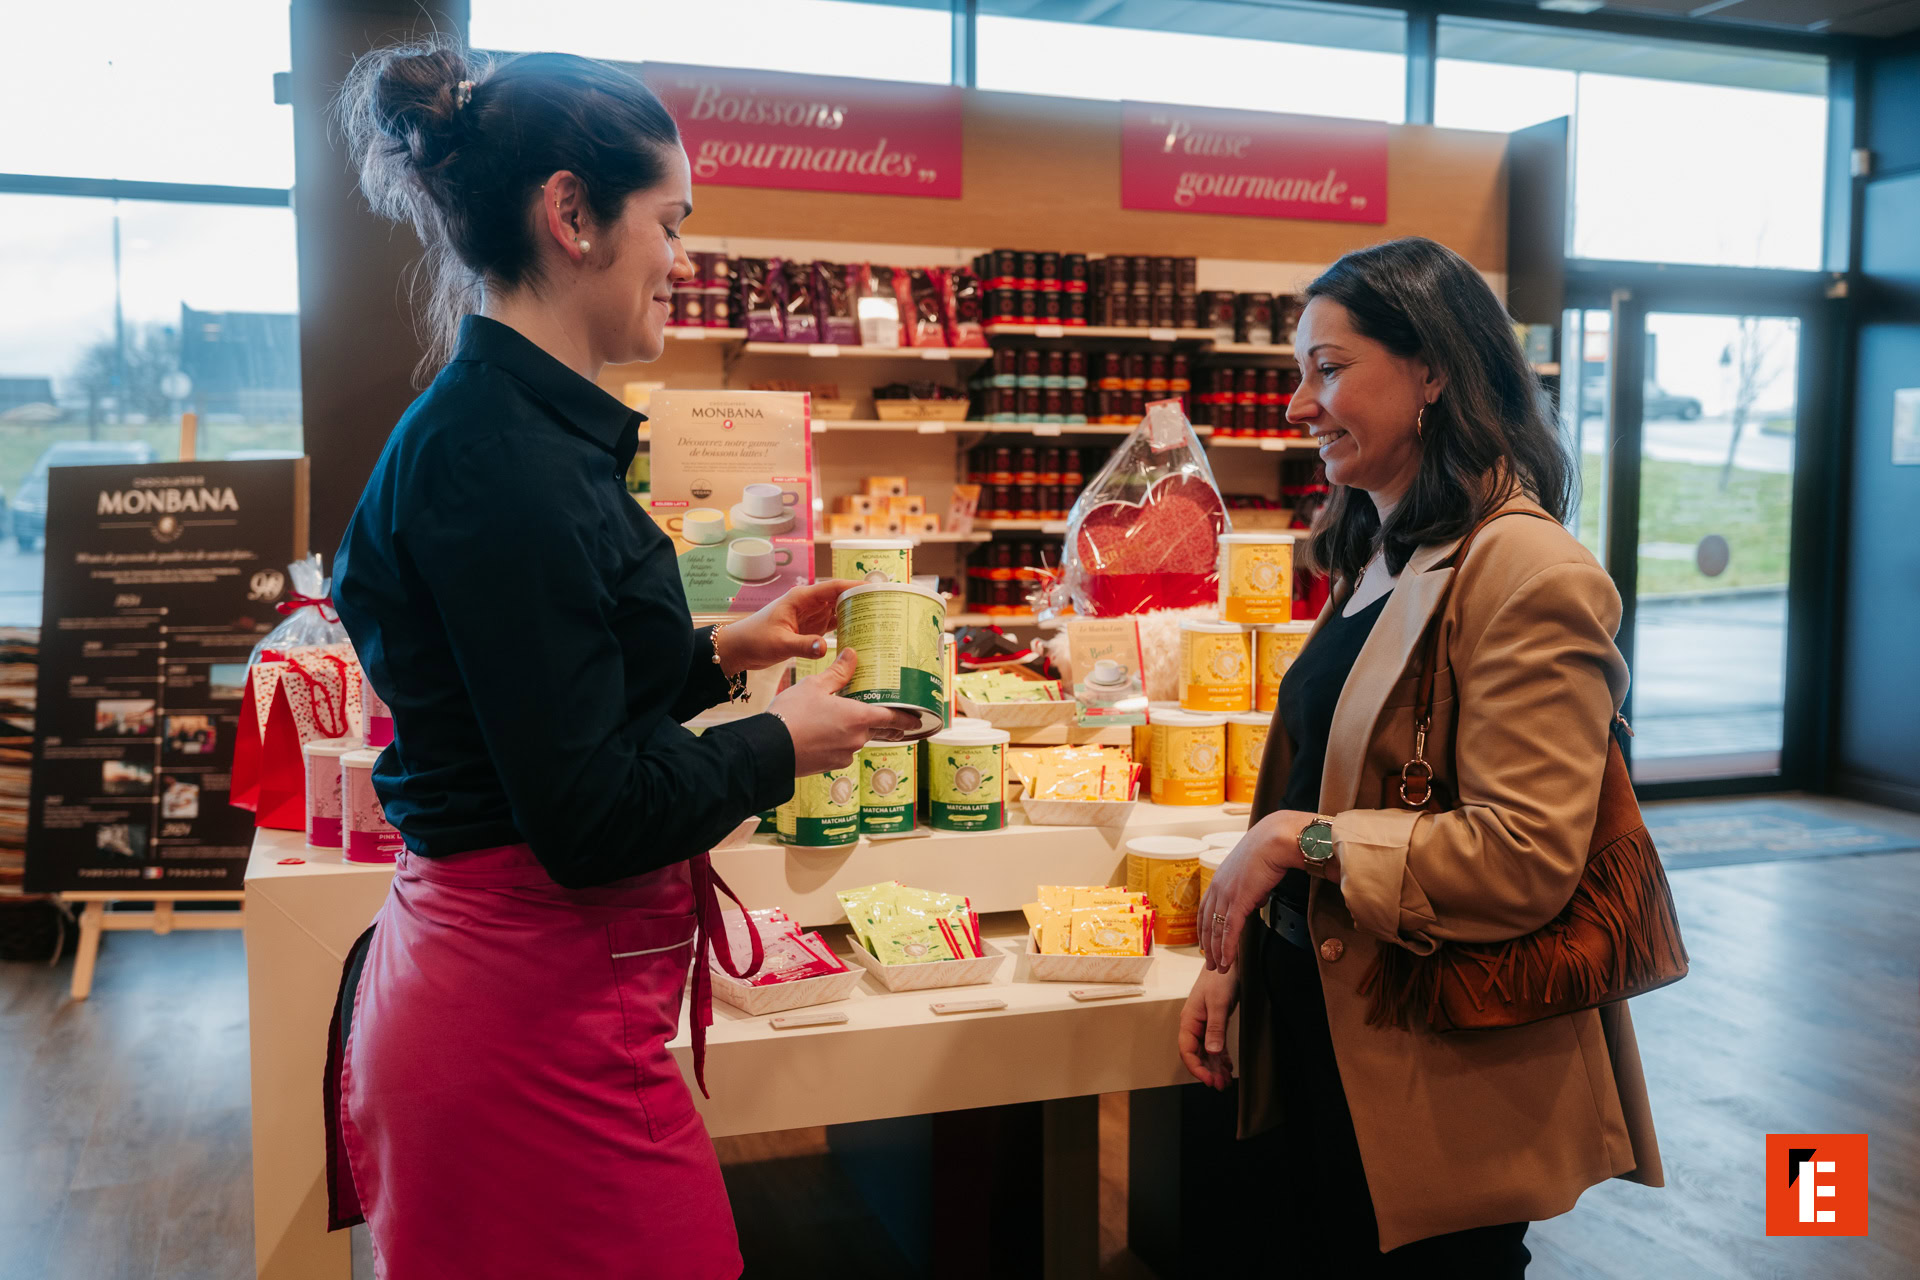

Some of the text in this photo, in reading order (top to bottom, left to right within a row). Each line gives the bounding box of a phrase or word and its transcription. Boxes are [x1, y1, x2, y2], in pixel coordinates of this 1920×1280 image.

[692, 407, 764, 419] MONBANA
[677, 436, 780, 449] Découvrez notre gamme
[689, 447, 701, 457] de
[702, 448, 739, 457] boissons
[740, 449, 763, 458] lattes
[97, 487, 240, 515] MONBANA
[863, 692, 881, 700] 500g
[846, 814, 858, 823] LATTE
